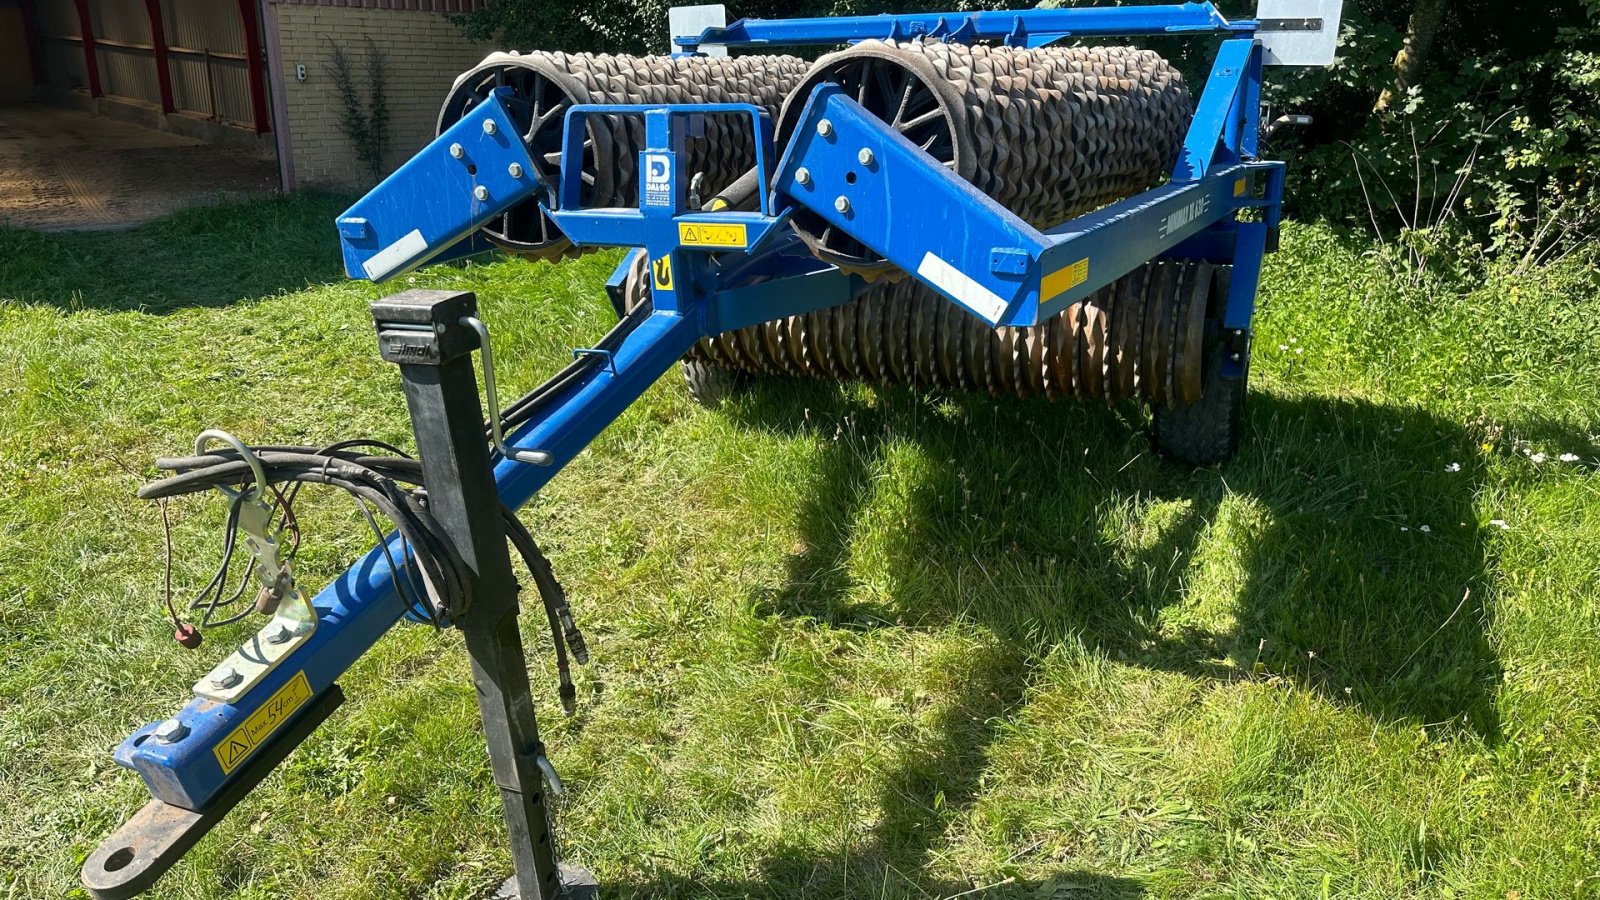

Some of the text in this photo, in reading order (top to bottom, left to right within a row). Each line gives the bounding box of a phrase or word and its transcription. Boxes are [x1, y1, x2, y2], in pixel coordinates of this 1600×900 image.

[251, 695, 294, 736] Max 54 cm
